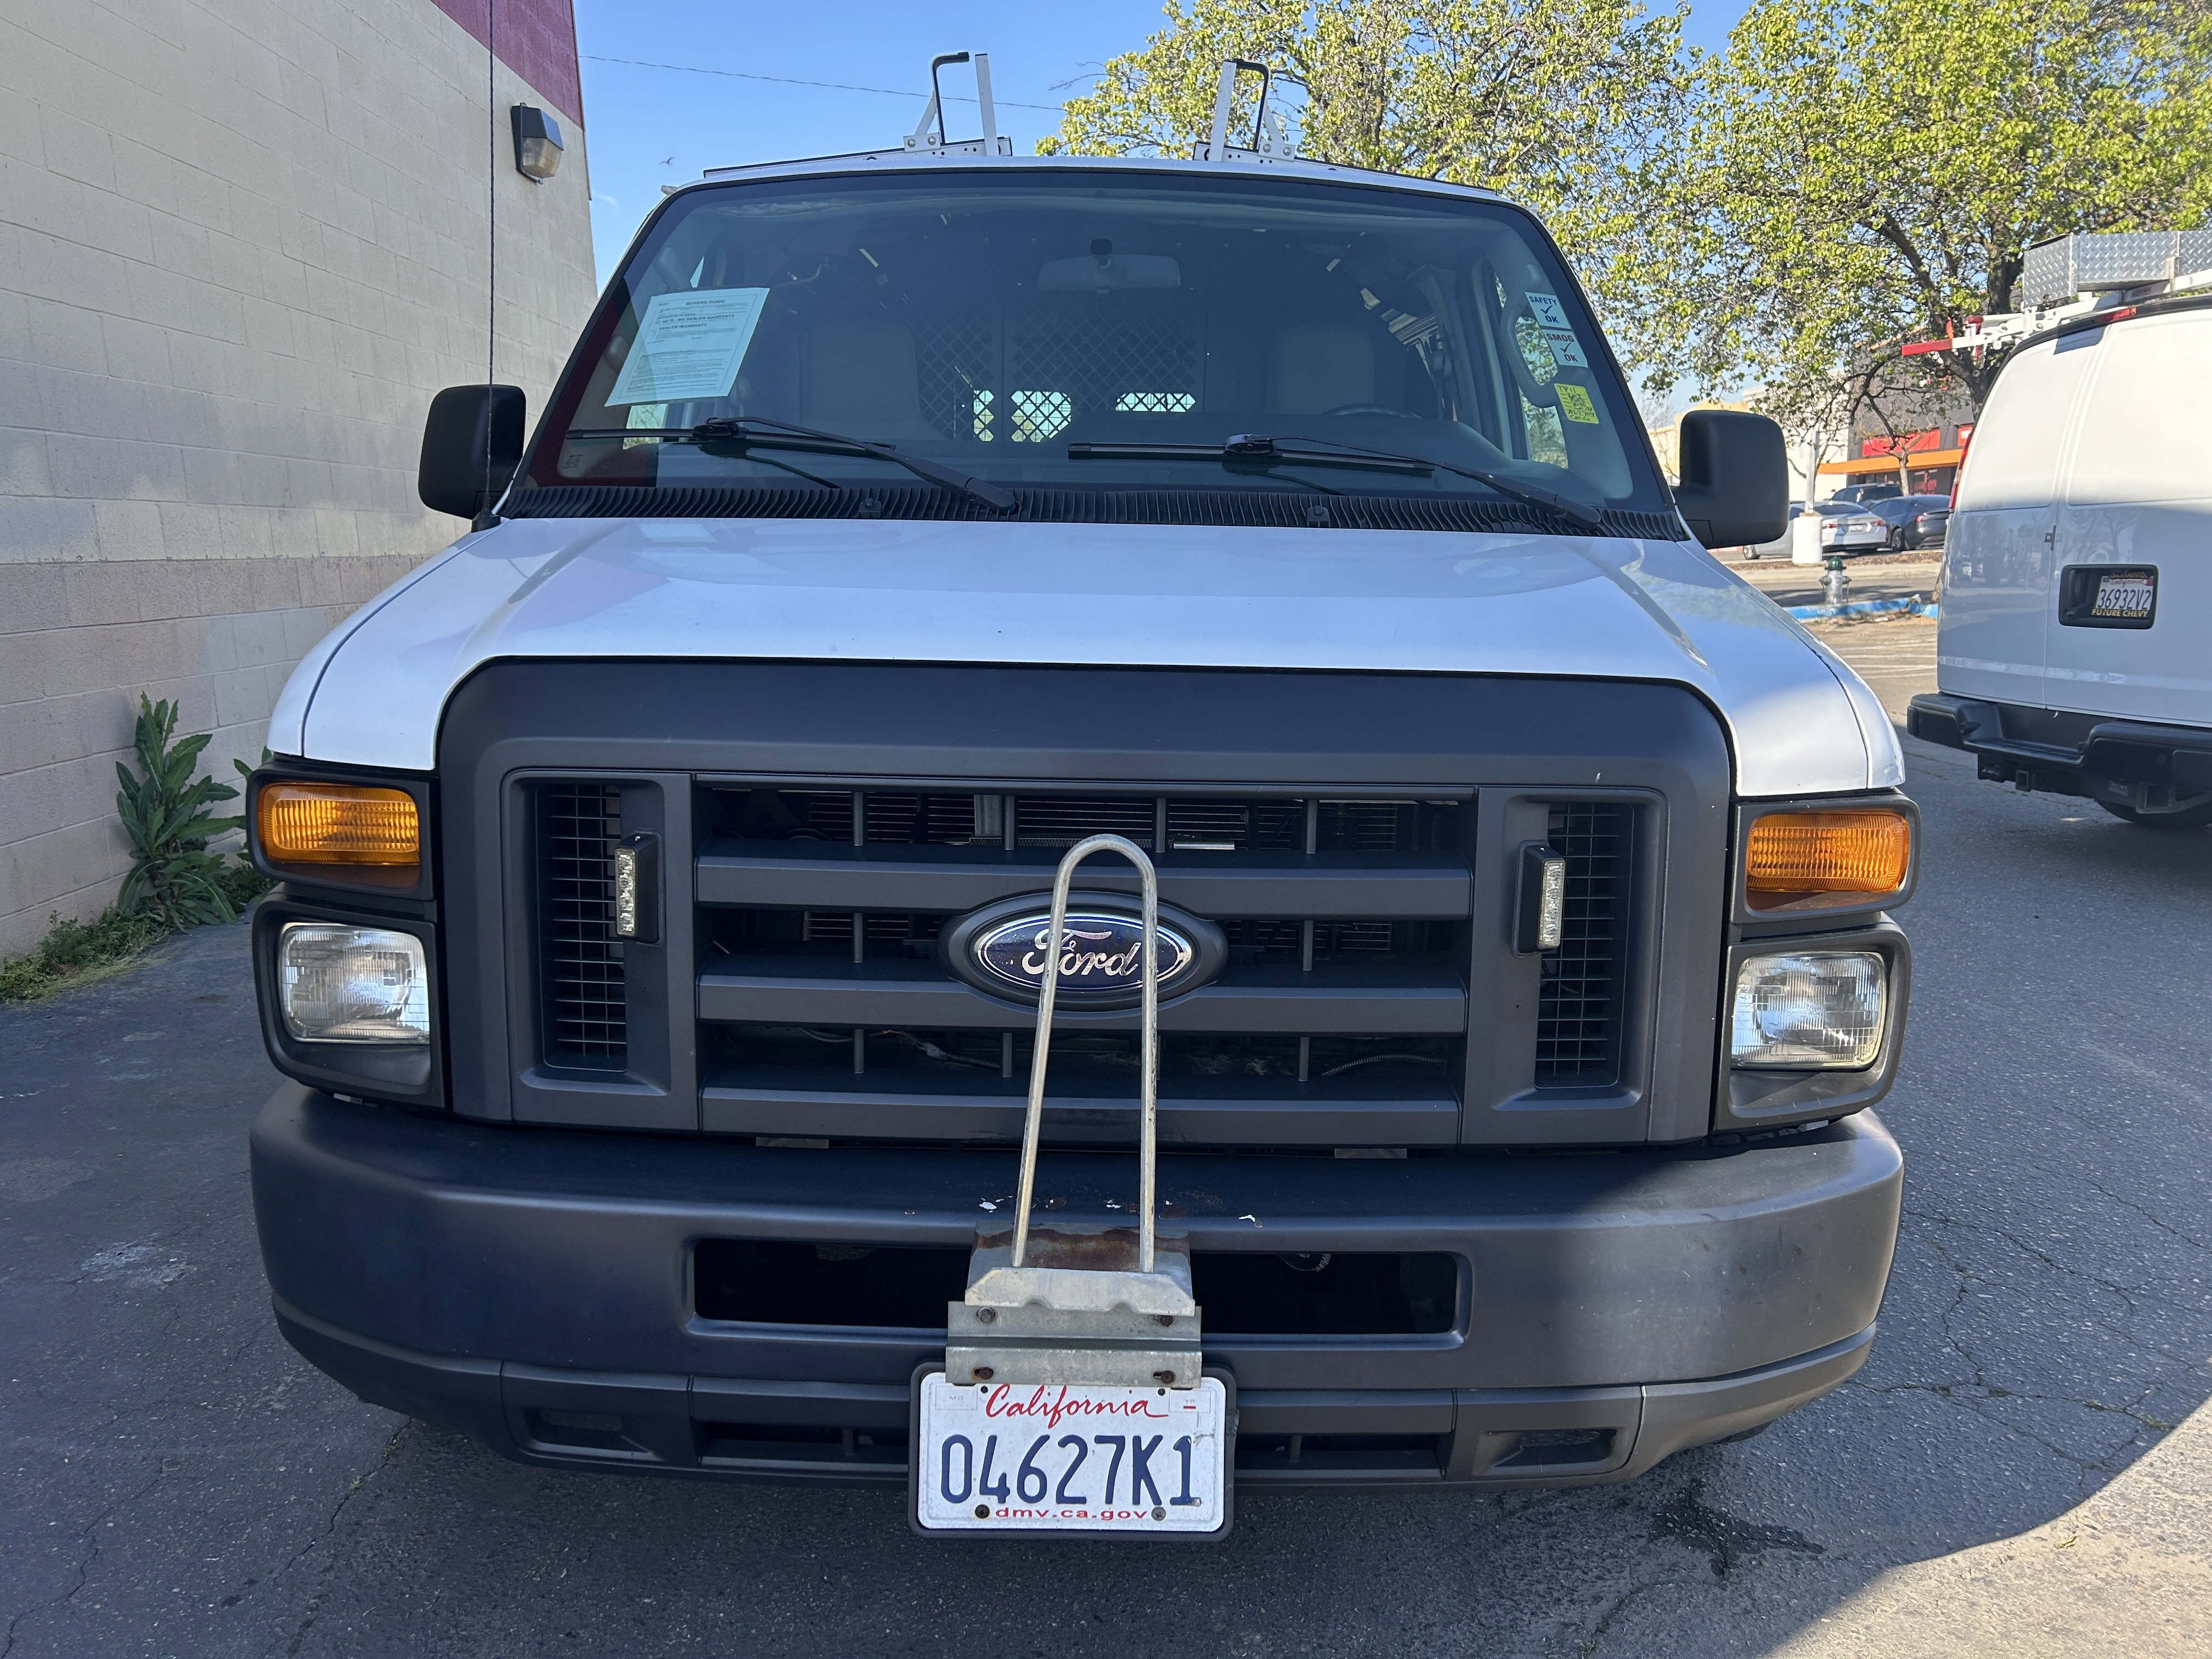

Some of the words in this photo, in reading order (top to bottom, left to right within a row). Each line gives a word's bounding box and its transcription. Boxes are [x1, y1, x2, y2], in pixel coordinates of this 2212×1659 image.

[1529, 296, 1556, 306] SAFETY
[1544, 315, 1559, 324] OK
[1546, 333, 1575, 342] SMOG
[1564, 354, 1578, 362] OK
[2097, 589, 2152, 610] 36932V2
[2091, 608, 2120, 617] FUTURE
[1022, 928, 1142, 976] Ford
[986, 1383, 1169, 1429] California
[941, 1434, 1201, 1506] 04627K1
[995, 1506, 1148, 1521] dmv.ca.gov
